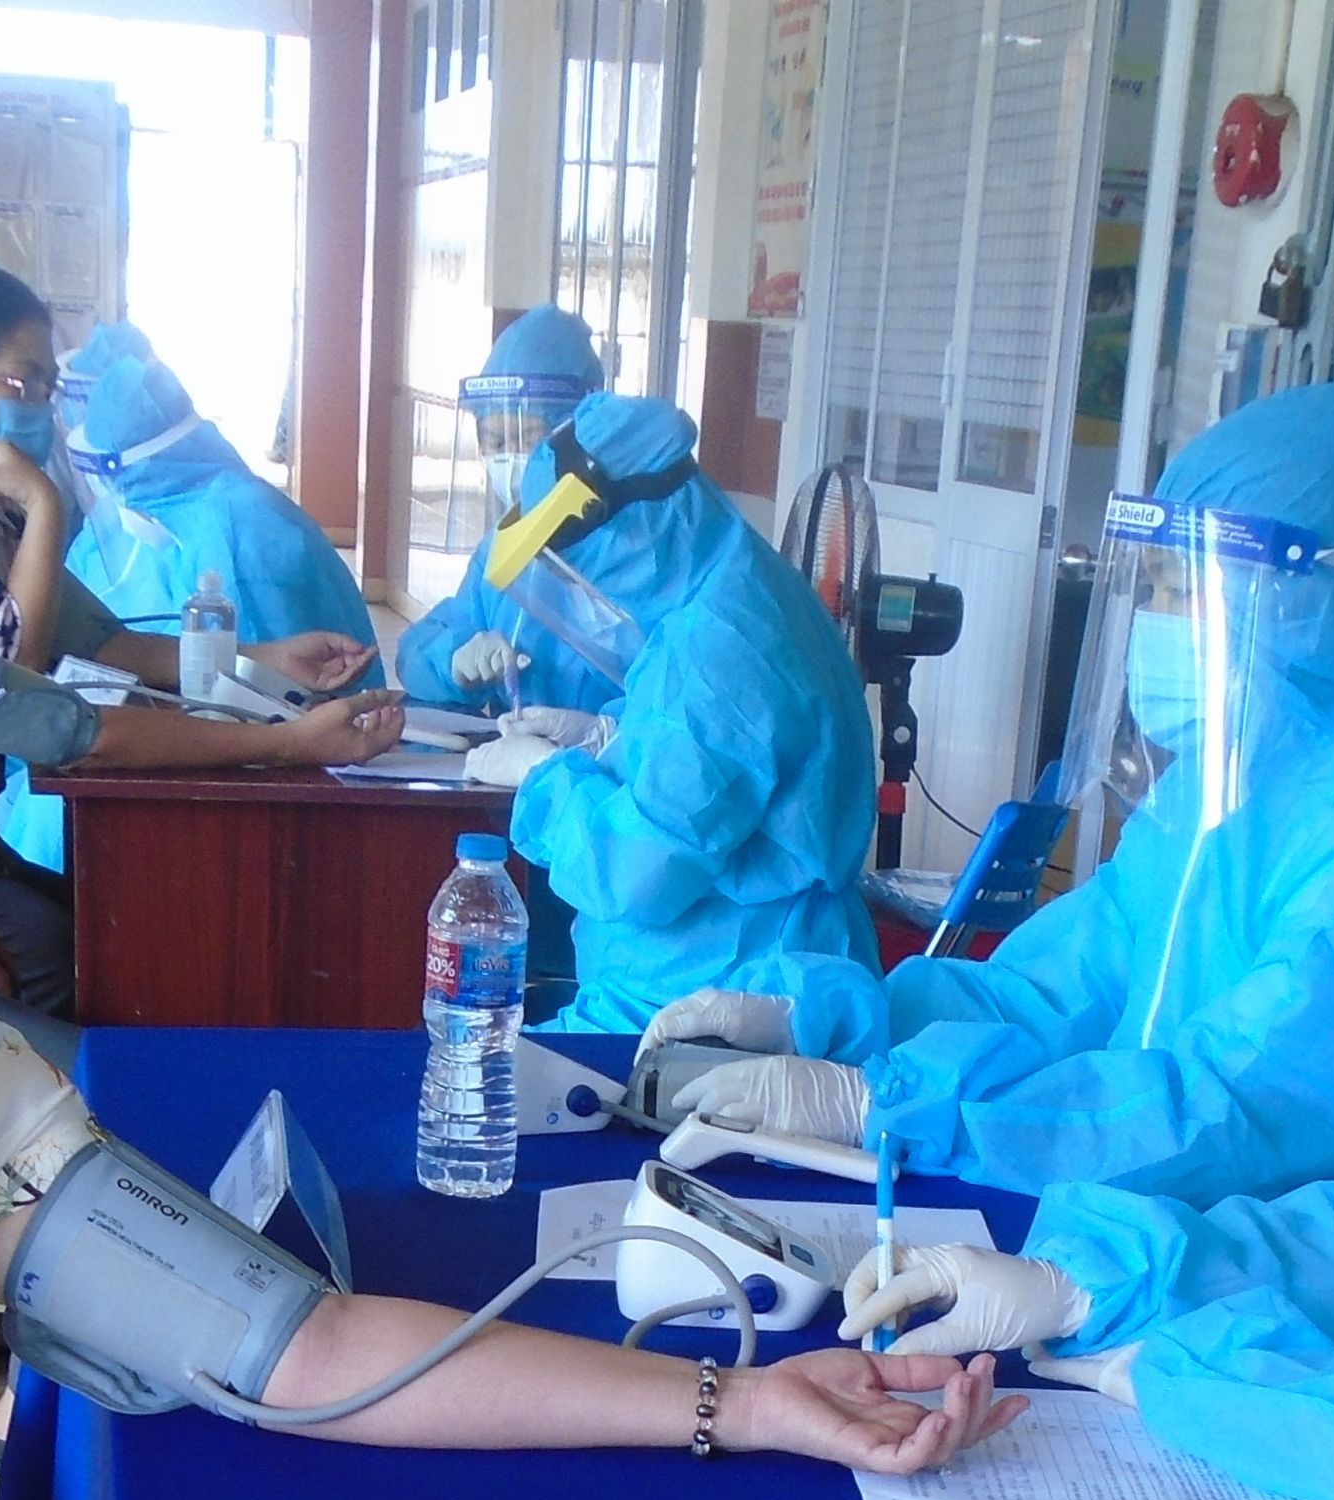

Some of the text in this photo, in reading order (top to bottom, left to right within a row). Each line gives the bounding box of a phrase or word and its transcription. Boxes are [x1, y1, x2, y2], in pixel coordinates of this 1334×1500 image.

[486, 378, 517, 389] Shield
[1118, 505, 1155, 523] Shield
[427, 953, 456, 978] 20%
